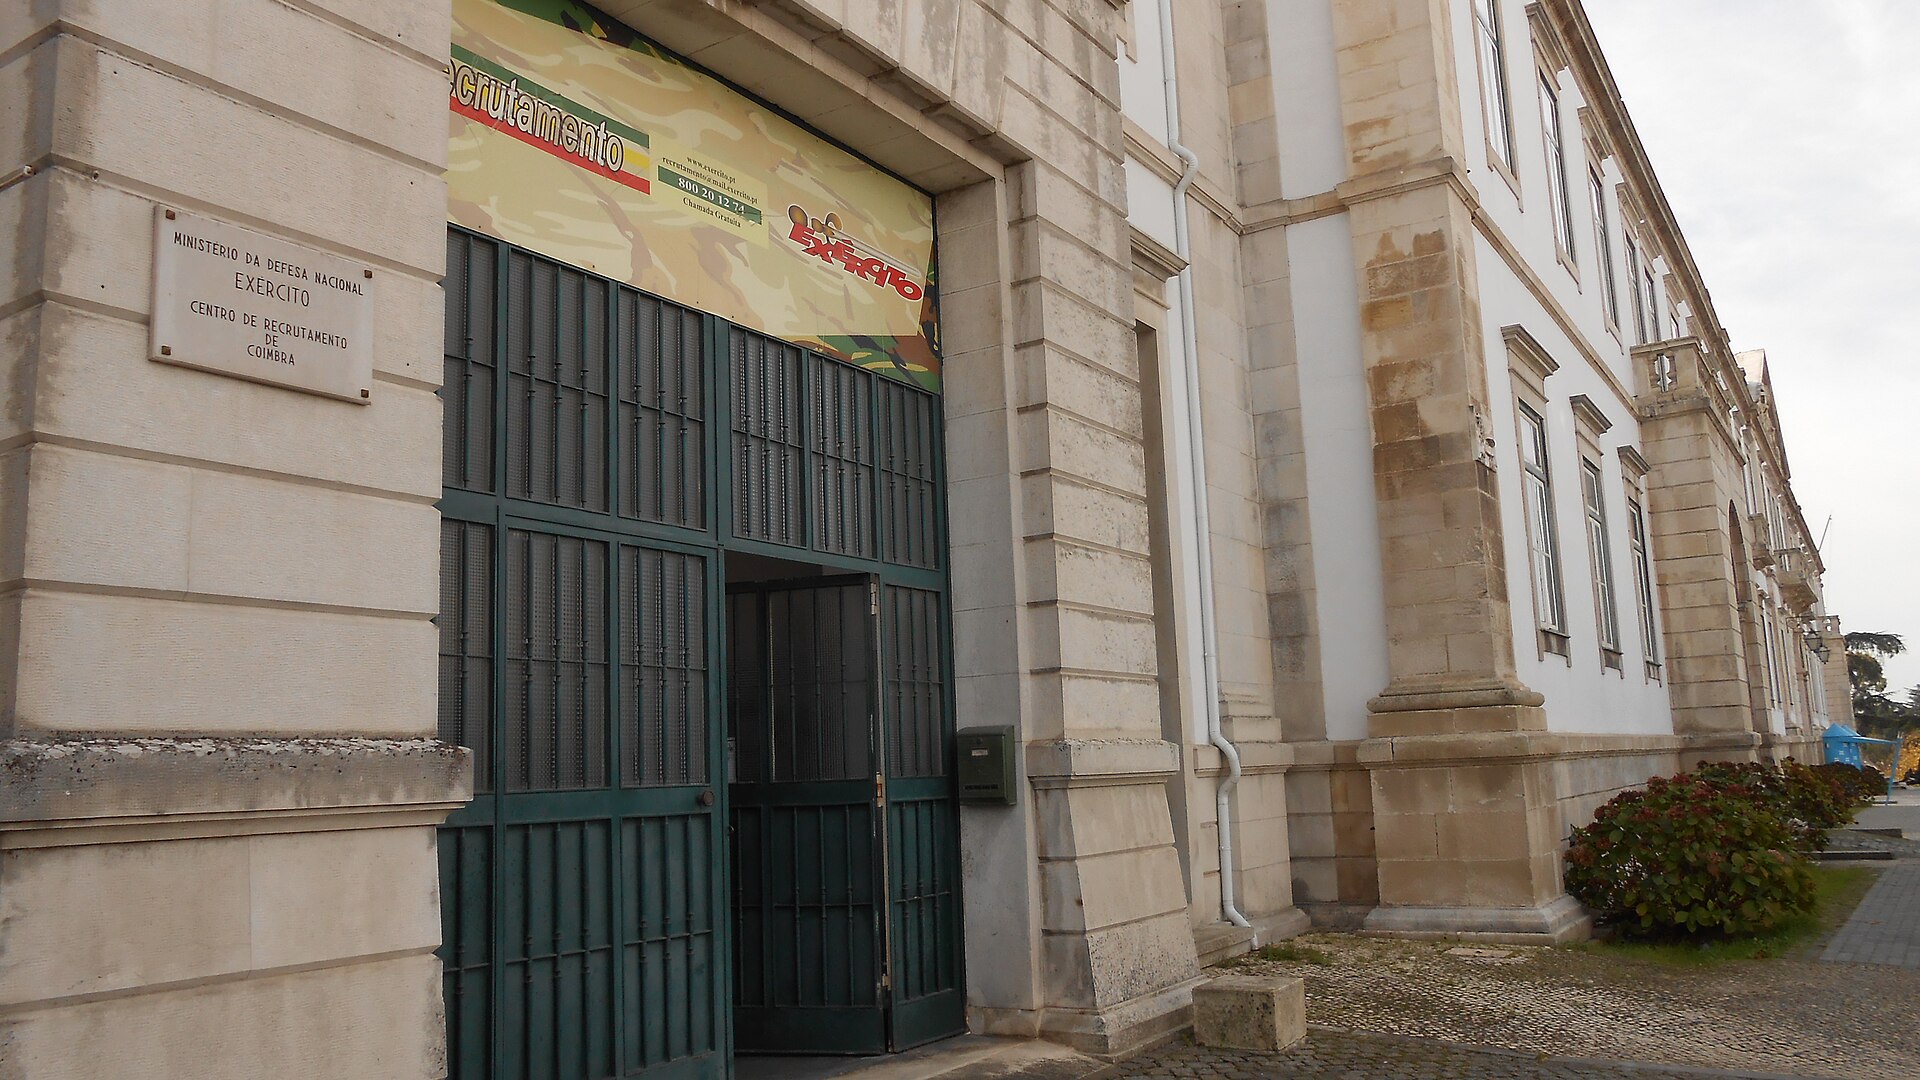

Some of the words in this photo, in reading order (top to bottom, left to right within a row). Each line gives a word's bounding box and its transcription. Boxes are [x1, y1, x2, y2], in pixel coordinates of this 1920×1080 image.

[686, 156, 736, 184] www.exercito.pt
[678, 177, 699, 194] 800
[702, 187, 715, 201] 20
[718, 195, 730, 208] 12
[732, 201, 746, 215] 74
[682, 196, 714, 217] Chamada
[715, 210, 741, 228] Gratuita
[174, 231, 238, 261] MINISTÉRIO
[245, 252, 260, 267] DA
[267, 258, 308, 281] DEFESA
[314, 271, 364, 296] NACIONAL
[235, 271, 310, 307] EXÉRCITO
[190, 300, 236, 322] CENTRO
[243, 312, 257, 327] DE
[264, 318, 347, 349] RECRUTAMENTO
[265, 333, 279, 348] DE
[247, 344, 295, 366] COIMBRA
